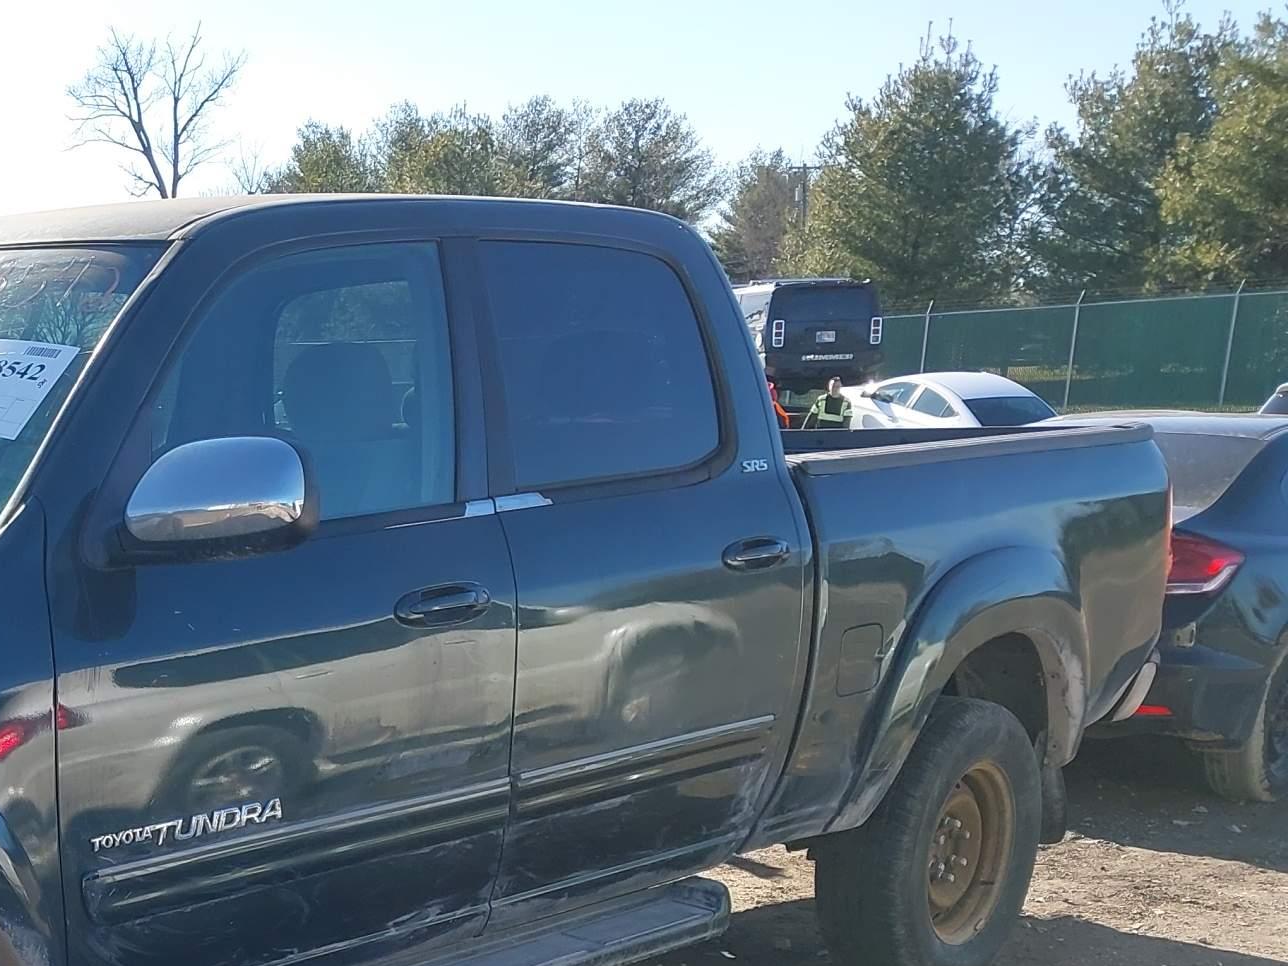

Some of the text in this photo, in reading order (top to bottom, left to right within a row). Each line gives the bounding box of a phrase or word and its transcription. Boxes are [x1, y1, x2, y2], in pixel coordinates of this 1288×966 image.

[742, 458, 769, 473] SR5
[91, 797, 283, 852] TOYOTA TUNDRA
